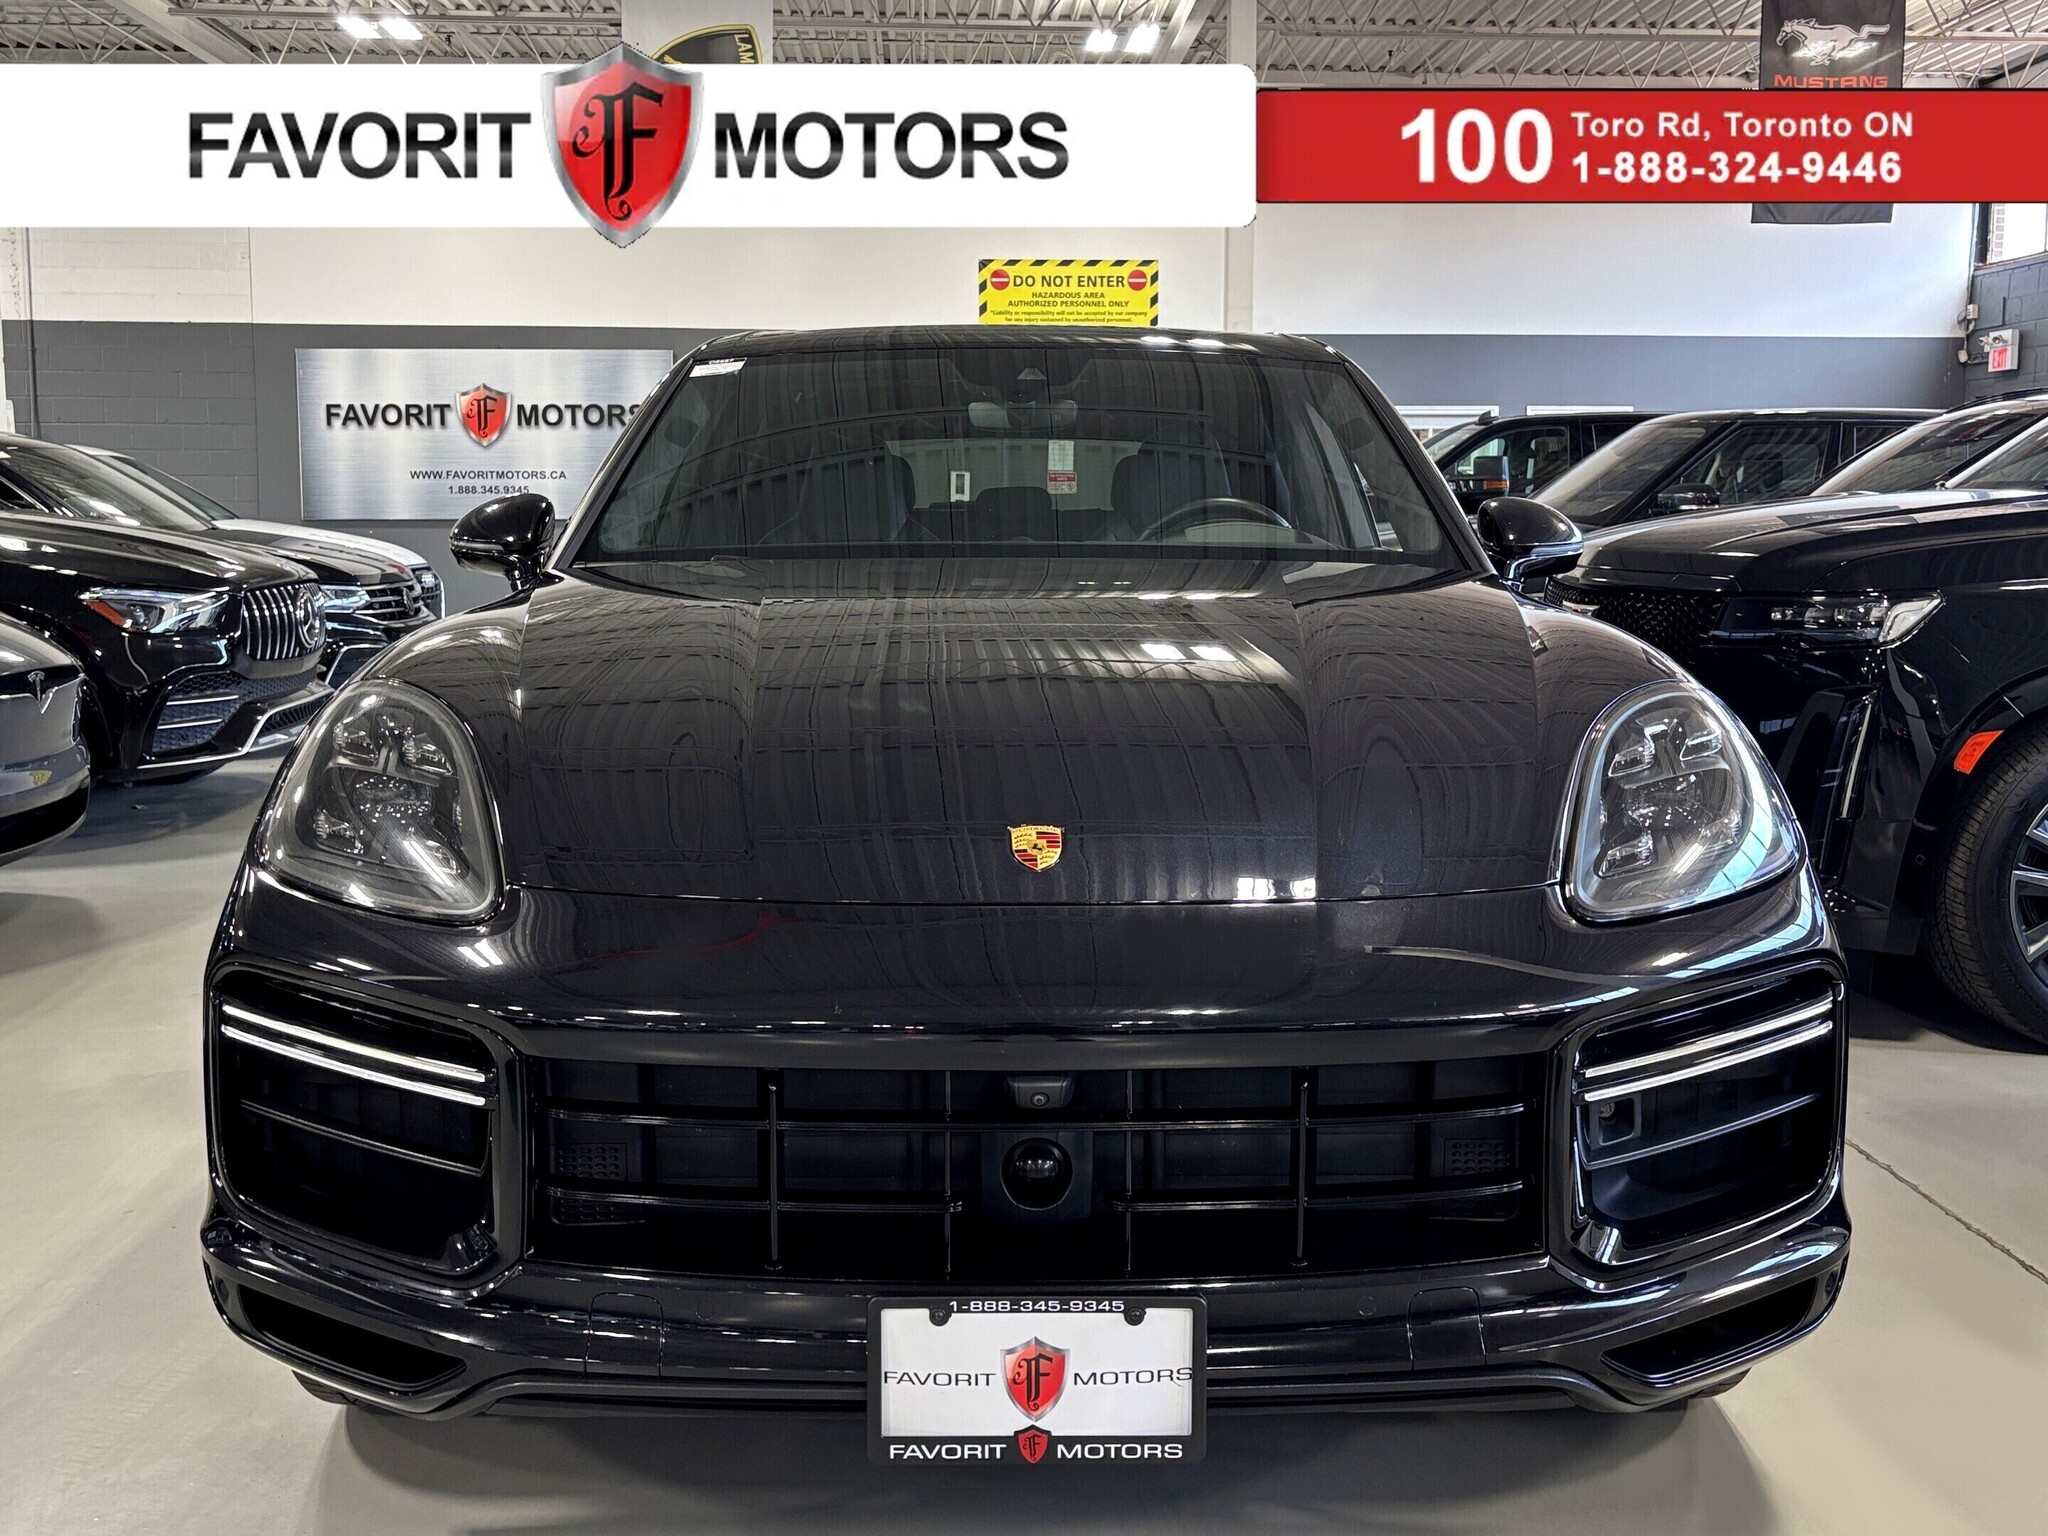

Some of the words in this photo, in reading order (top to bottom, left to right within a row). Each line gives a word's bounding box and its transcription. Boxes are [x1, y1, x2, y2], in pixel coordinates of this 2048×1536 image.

[1774, 74, 1888, 88] MUSTANG
[1013, 275, 1036, 287] DO
[1042, 275, 1073, 287] NOT
[1077, 275, 1125, 287] ENTER
[325, 403, 450, 427] FAVORIT
[410, 470, 567, 480] WWW.FAVORITMOTORS.CA
[448, 485, 530, 495] 1.888.345.9345
[949, 1300, 1125, 1312] 1-888-345-9345
[884, 1371, 996, 1387] FAVORIT
[1073, 1366, 1193, 1387] MOTORS
[889, 1444, 1007, 1460] FAVORIT
[1057, 1443, 1183, 1460] MOTORS
